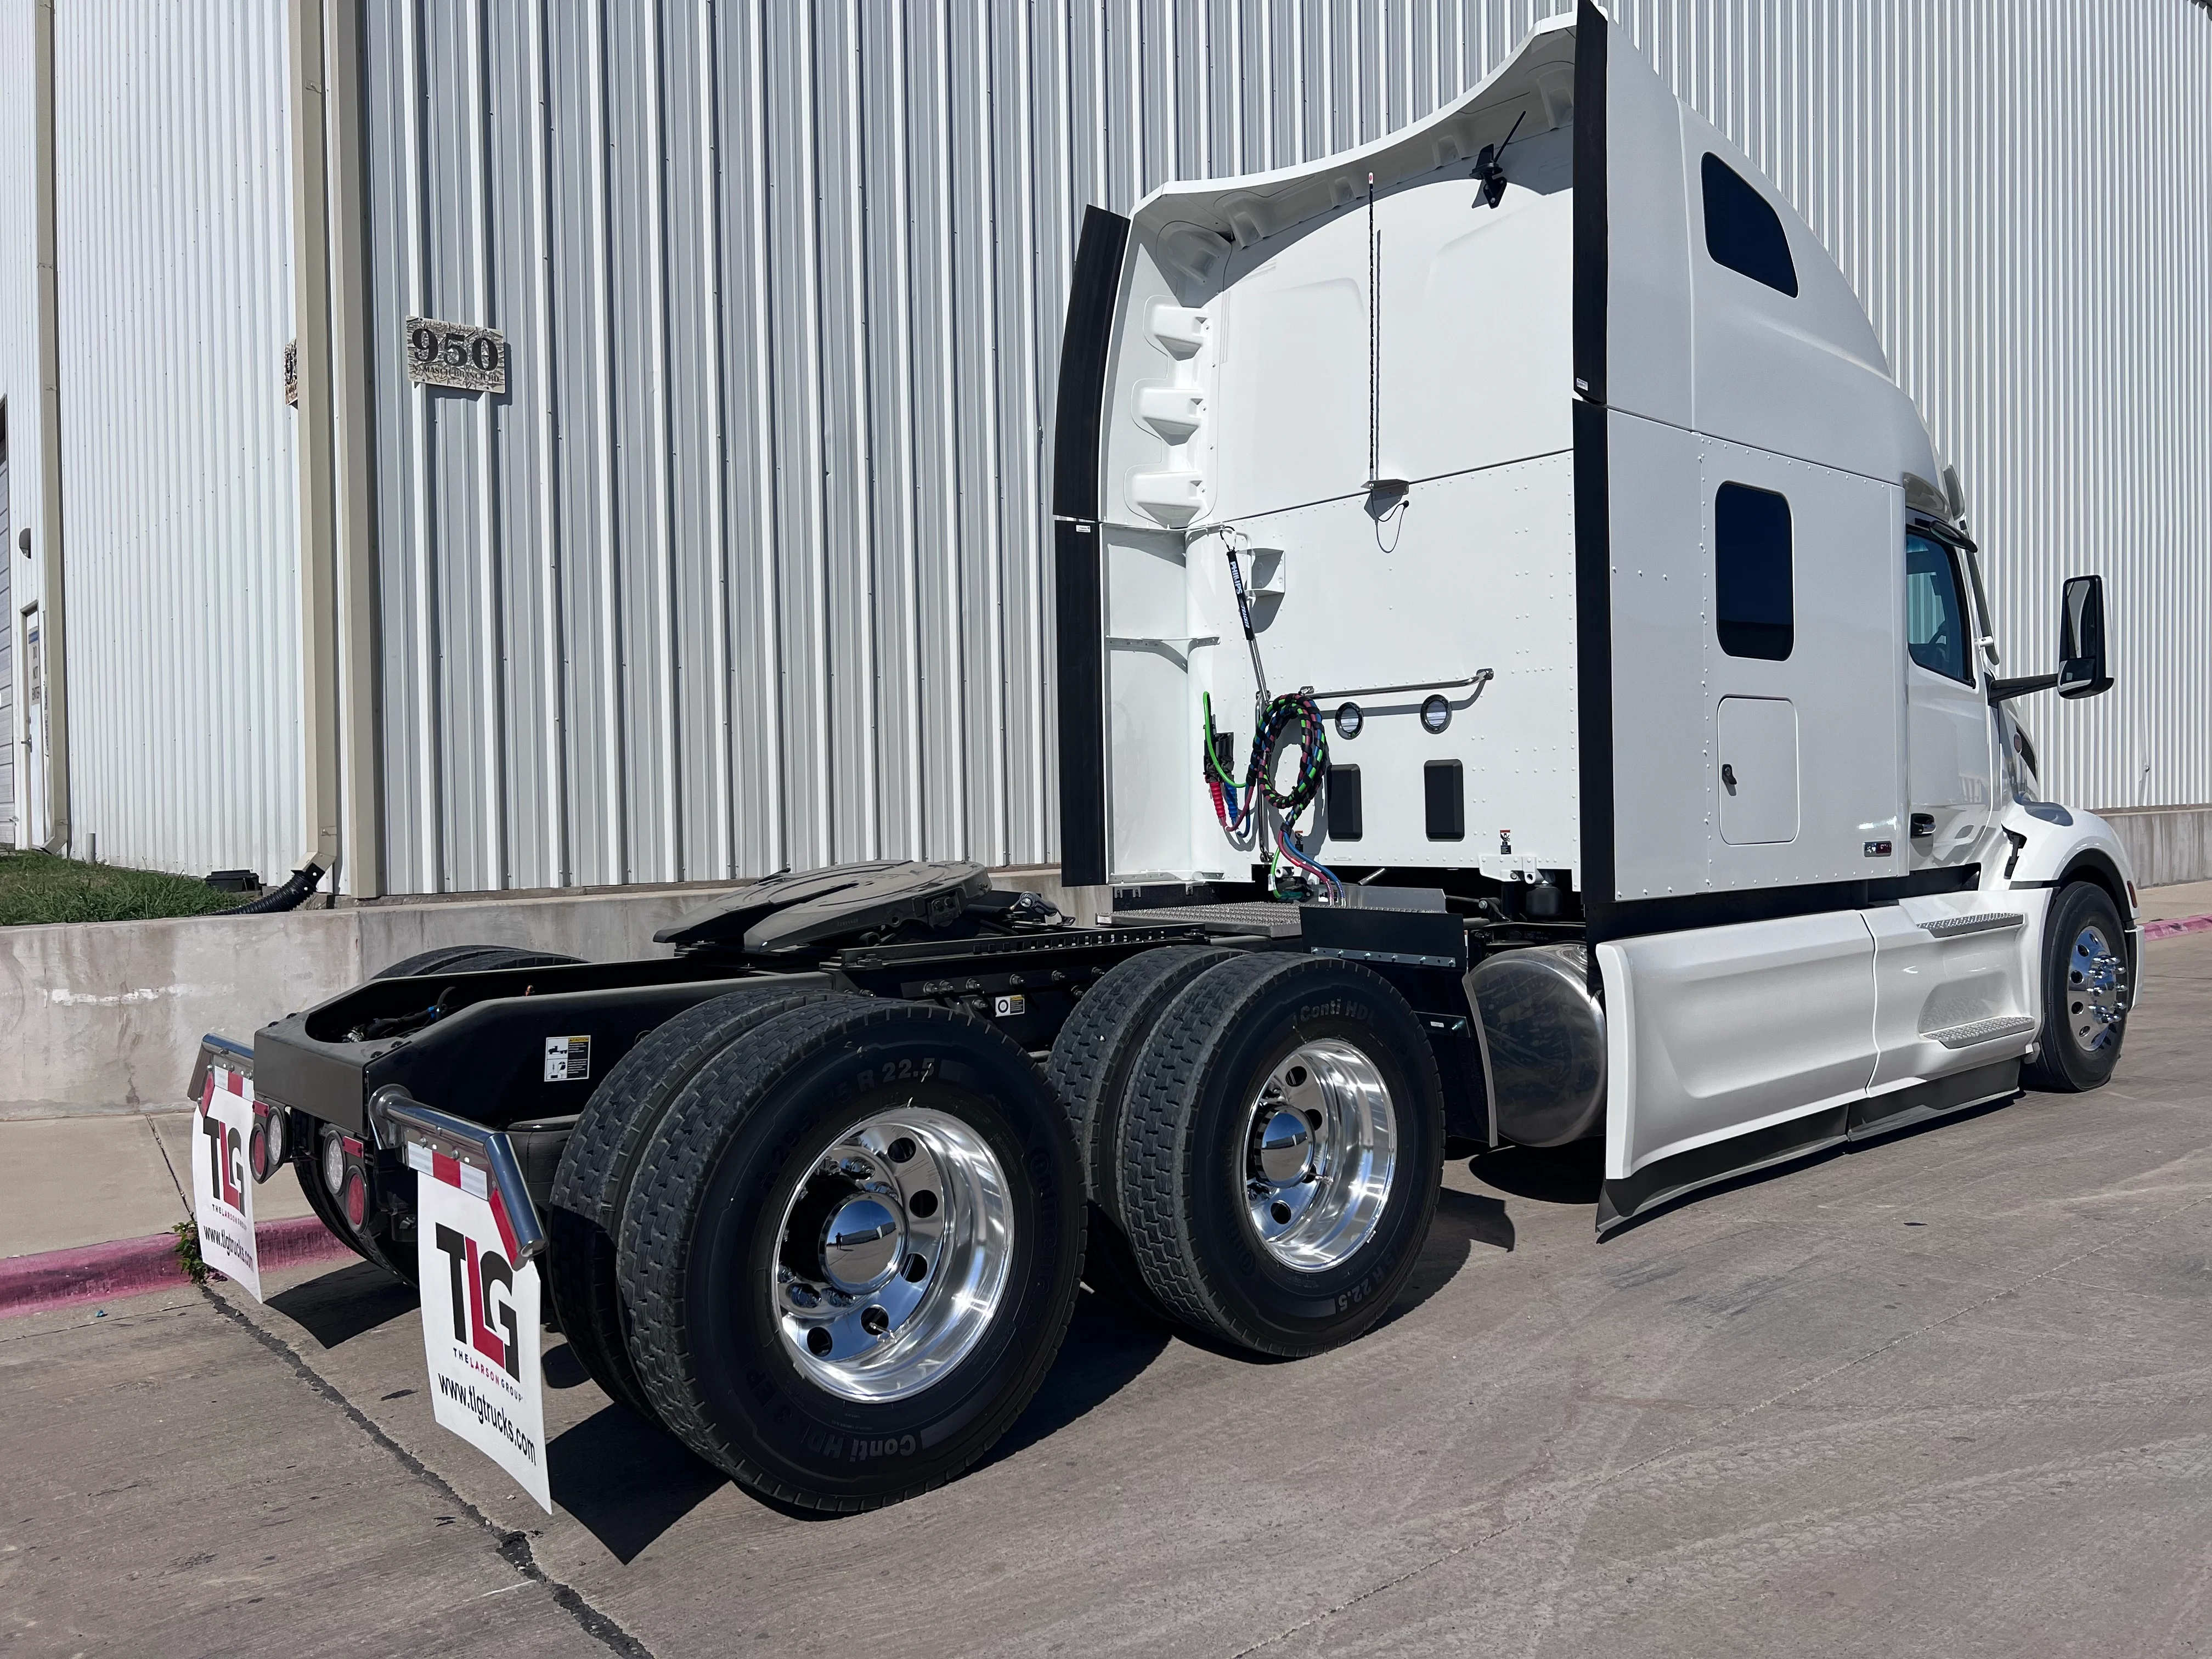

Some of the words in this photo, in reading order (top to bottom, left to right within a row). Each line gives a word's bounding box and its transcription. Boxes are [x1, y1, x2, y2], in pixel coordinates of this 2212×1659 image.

[412, 329, 498, 371] 950
[424, 365, 452, 376] MASCH
[454, 370, 486, 381] BRANCH
[1230, 561, 1243, 595] PHILLIPS
[1300, 996, 1341, 1022] Conti
[856, 1070, 875, 1092] R
[882, 1058, 935, 1083] 22.5
[203, 1116, 246, 1217] TLG
[204, 1225, 254, 1273] www.tlgtrucks.com
[1372, 1265, 1385, 1284] R
[436, 1222, 520, 1383] TLG
[1339, 1278, 1372, 1312] 22.5
[453, 1347, 469, 1363] THE
[470, 1357, 499, 1386] LARSON
[438, 1373, 536, 1466] www.tlgtrucks.com
[849, 1434, 916, 1462] Conti
